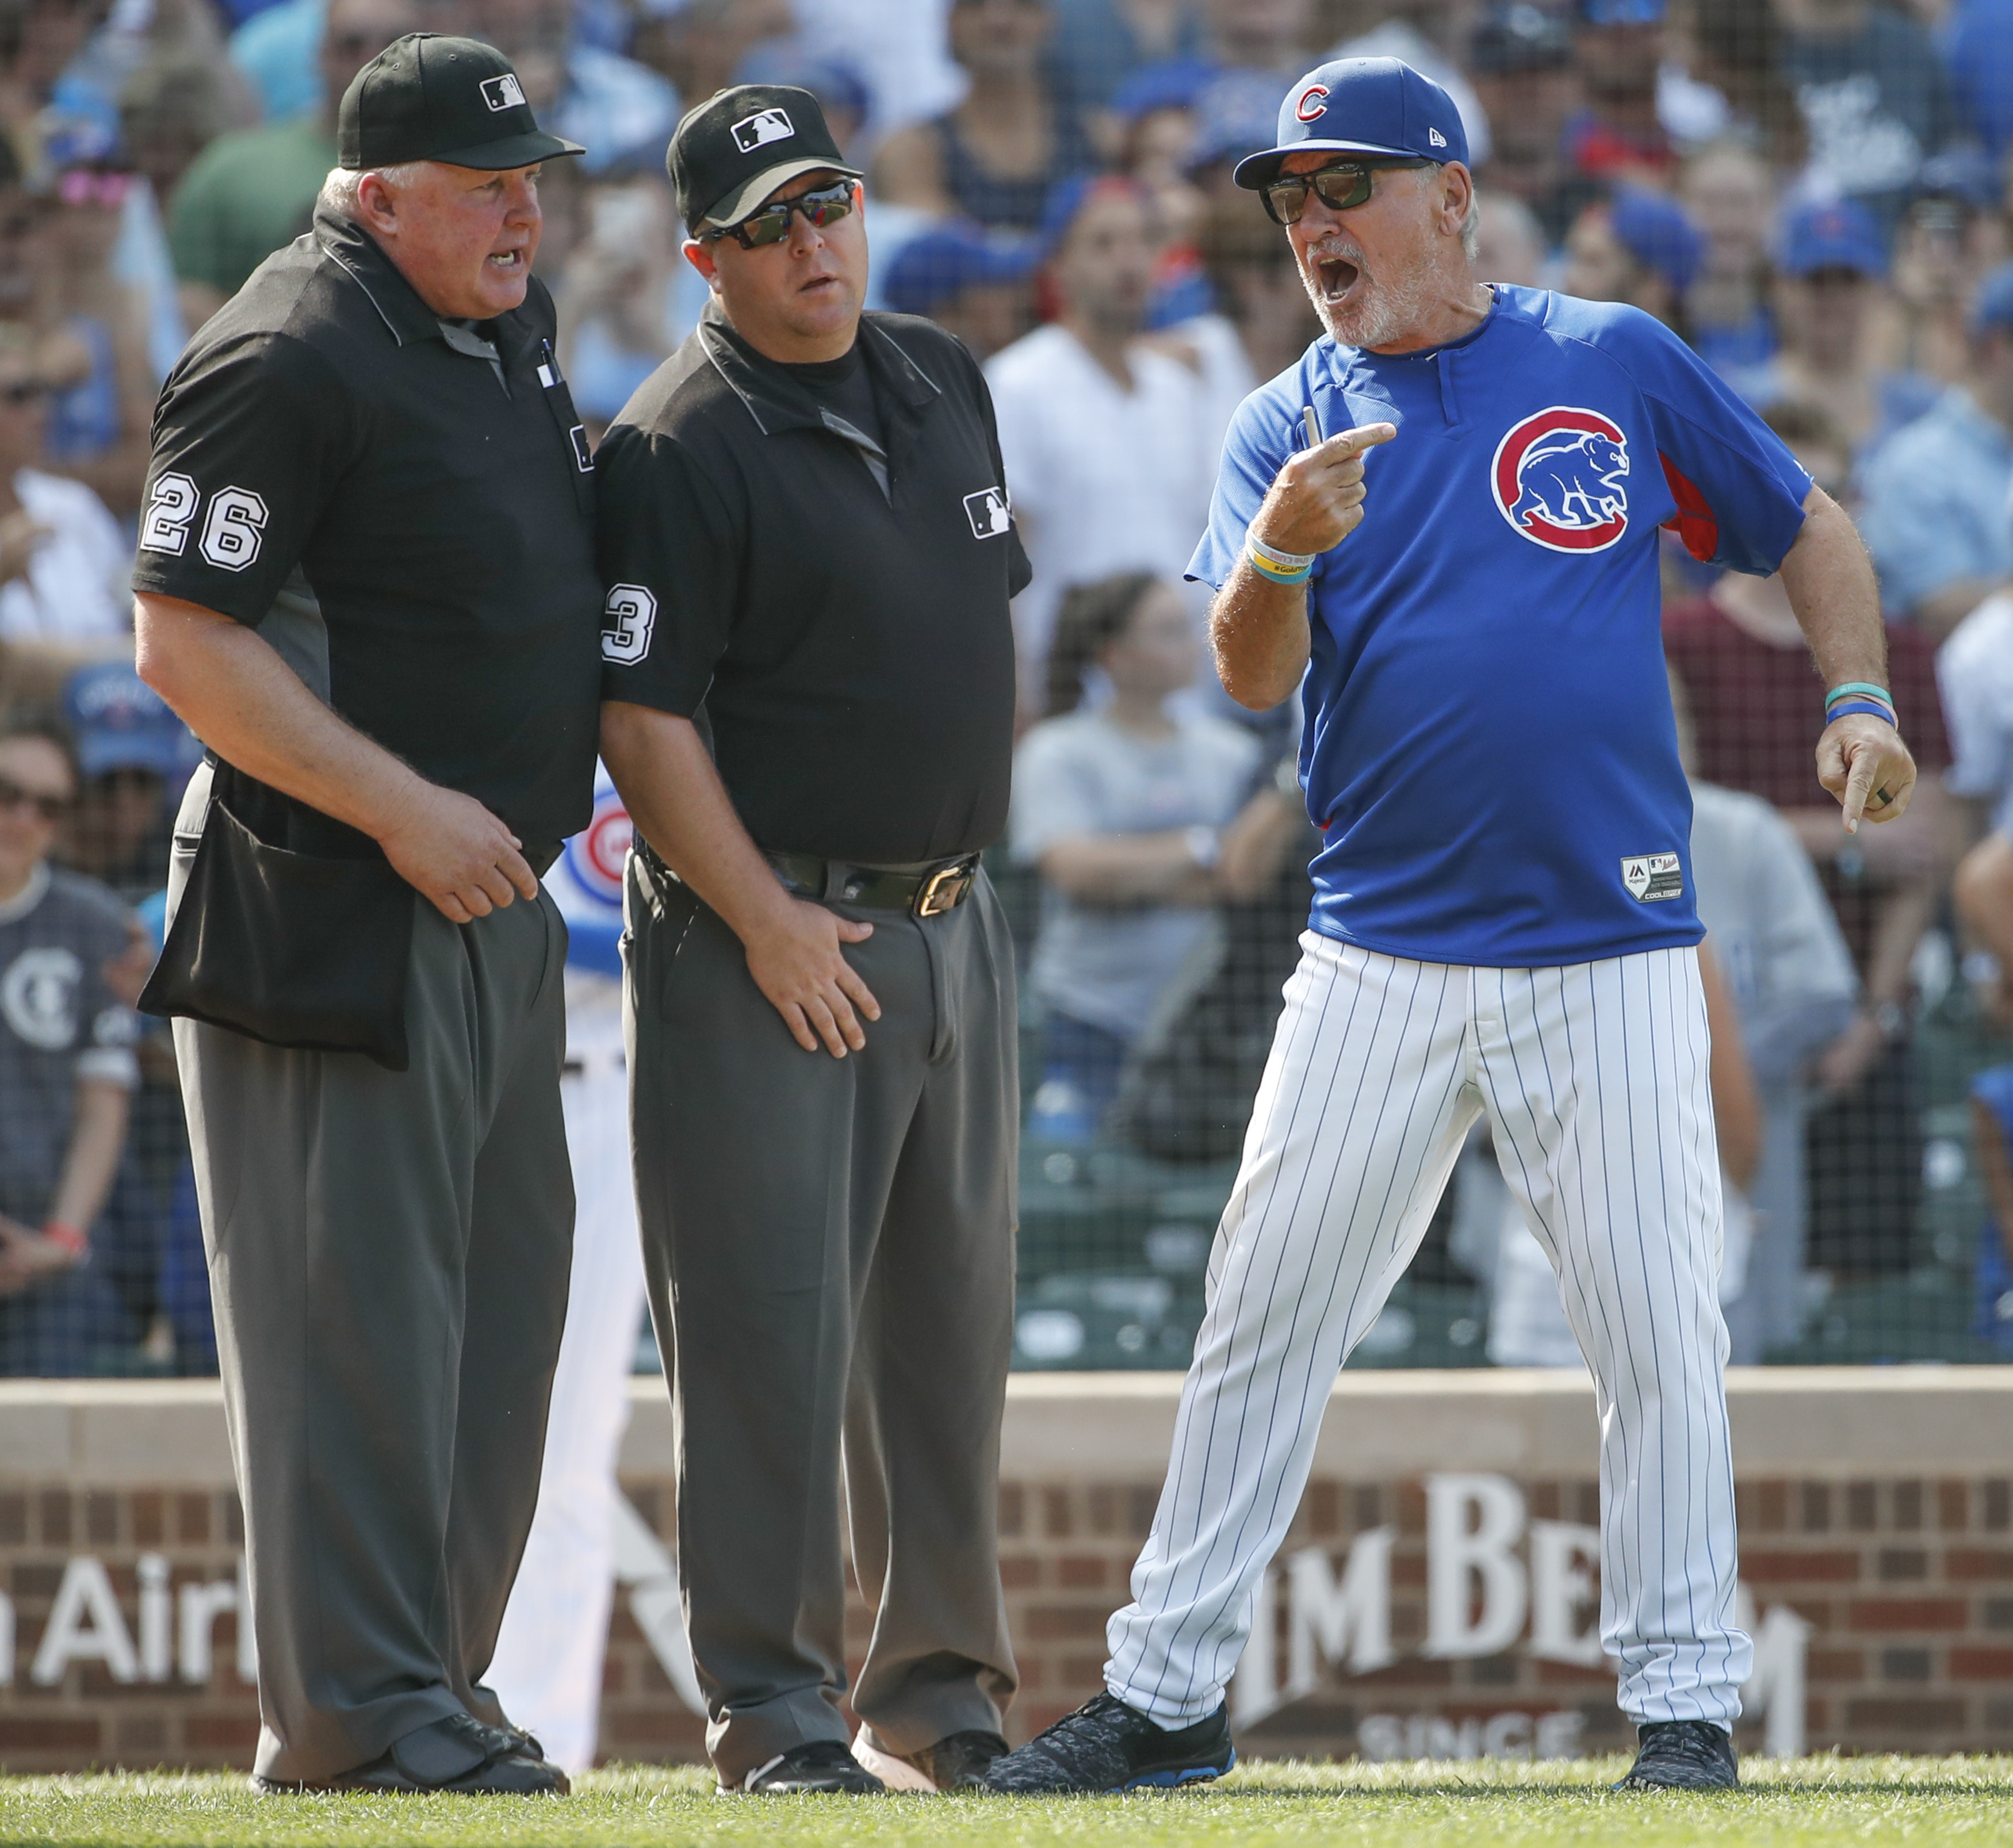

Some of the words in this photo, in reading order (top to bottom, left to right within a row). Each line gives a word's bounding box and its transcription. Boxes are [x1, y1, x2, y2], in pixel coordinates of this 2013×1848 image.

[1295, 84, 1330, 123] C
[140, 470, 270, 573] 26
[600, 583, 658, 666] 3
[1233, 1525, 1400, 1732] IM
[1419, 1471, 1815, 1758] BEM
